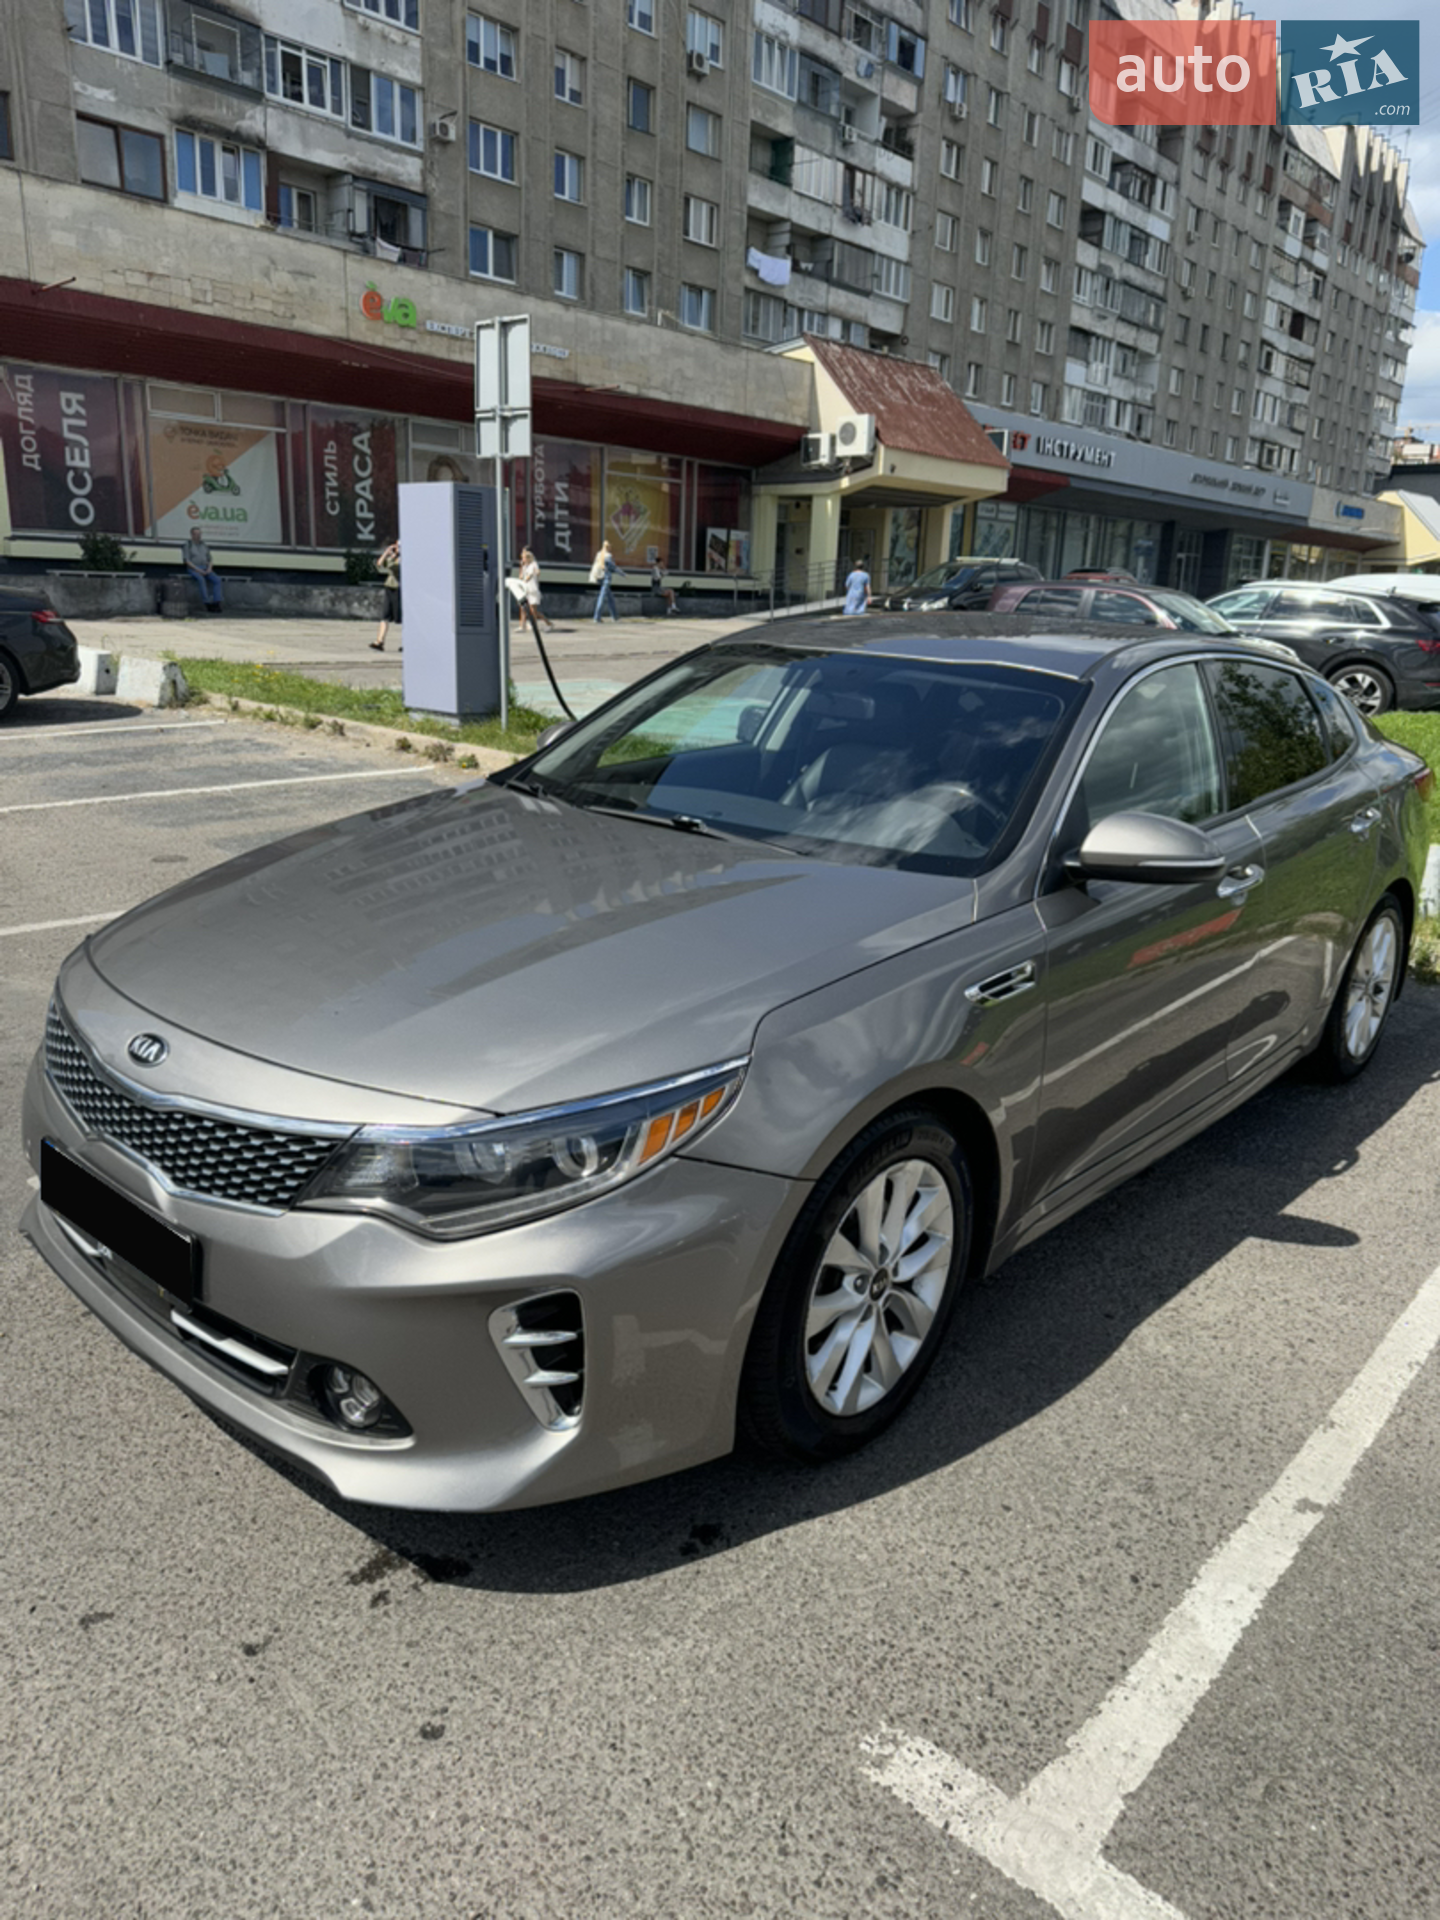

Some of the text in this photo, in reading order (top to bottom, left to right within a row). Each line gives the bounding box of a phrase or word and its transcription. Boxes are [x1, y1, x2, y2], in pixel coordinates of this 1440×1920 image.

[15, 374, 42, 472] ДОГЛЯД
[59, 391, 96, 527] ОСЕЛЯ
[1037, 435, 1117, 468] ІНСТРУМЕНТ
[323, 440, 340, 517] СТИЛЬ
[353, 431, 376, 542] КРАСА
[534, 443, 546, 531] ТУРБОТА
[554, 481, 572, 554] ДІТИ
[129, 1036, 162, 1062] KIA
